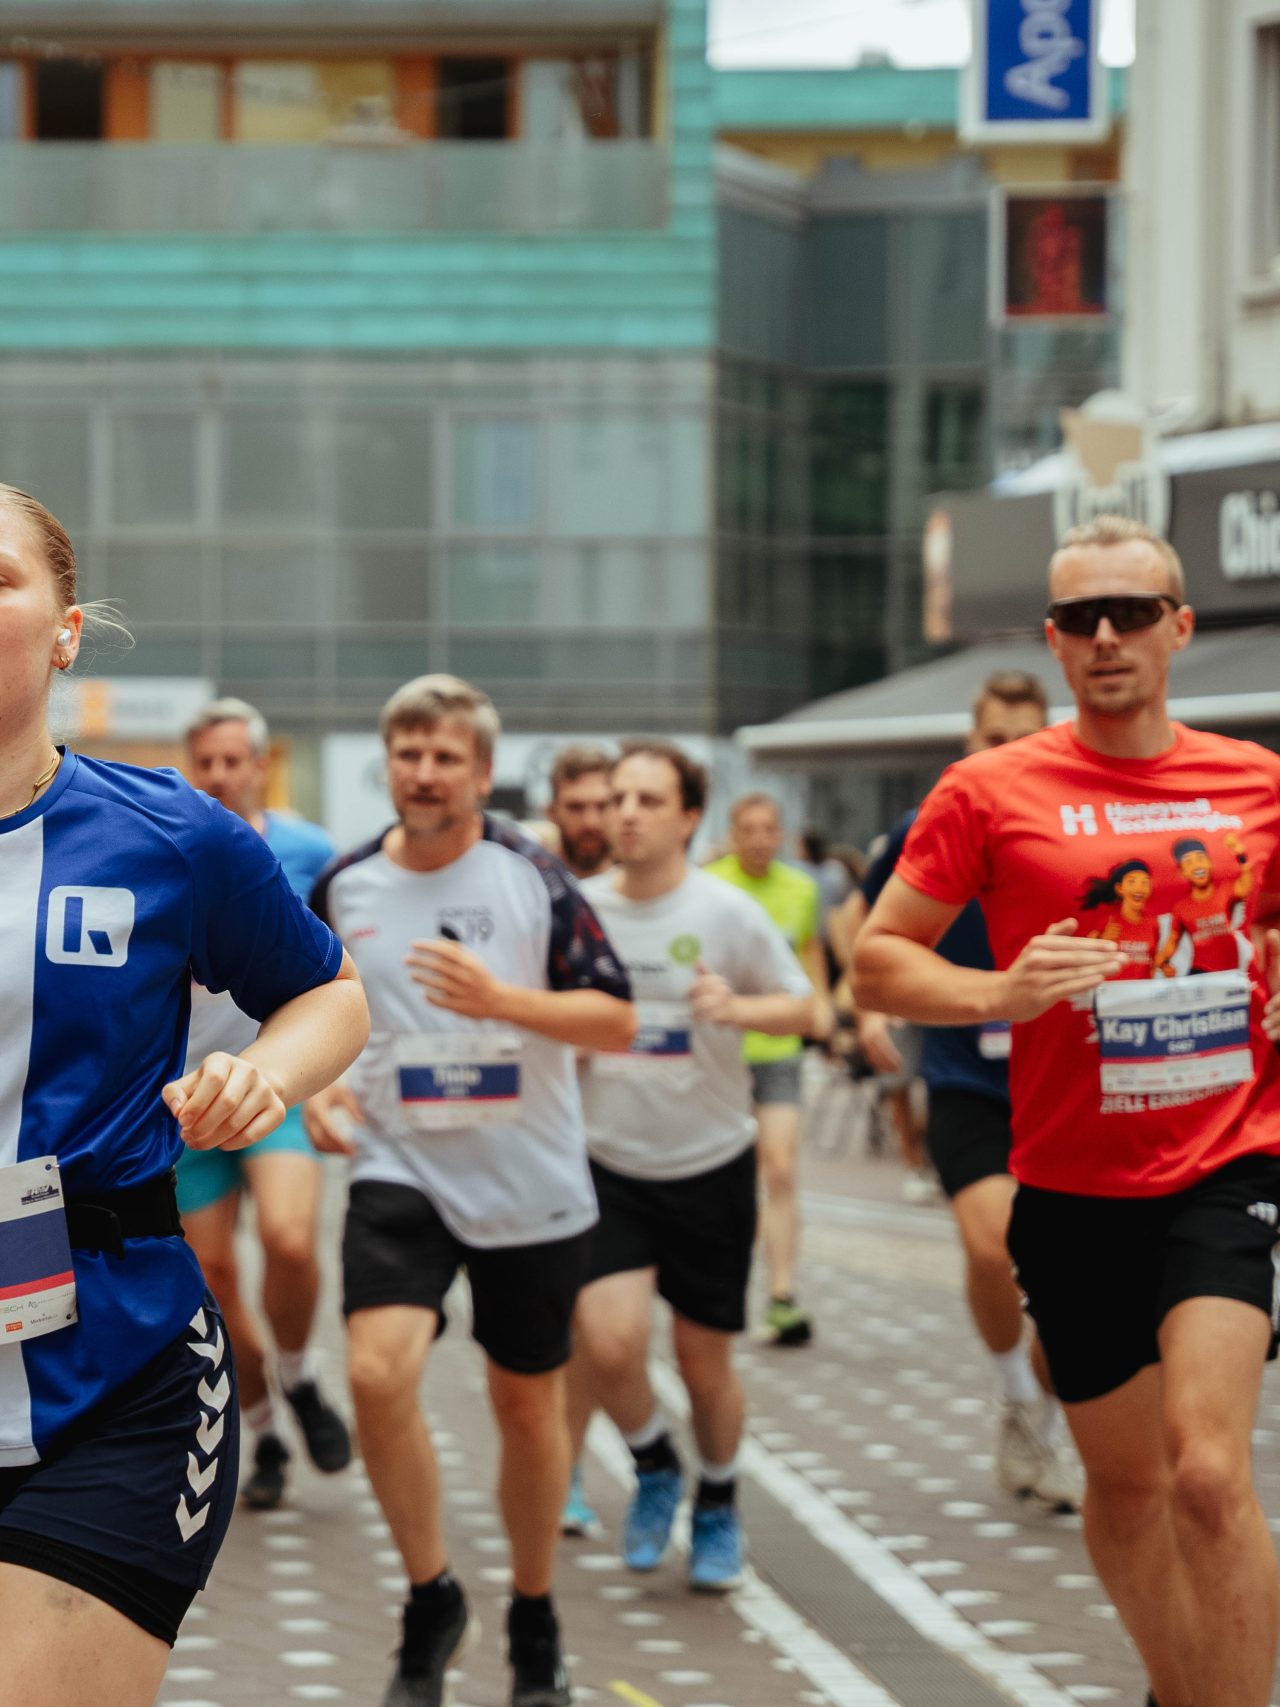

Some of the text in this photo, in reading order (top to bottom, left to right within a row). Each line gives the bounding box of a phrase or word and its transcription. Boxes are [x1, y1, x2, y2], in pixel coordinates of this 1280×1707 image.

[1060, 804, 1098, 836] H
[1101, 1008, 1249, 1047] Kay Christian
